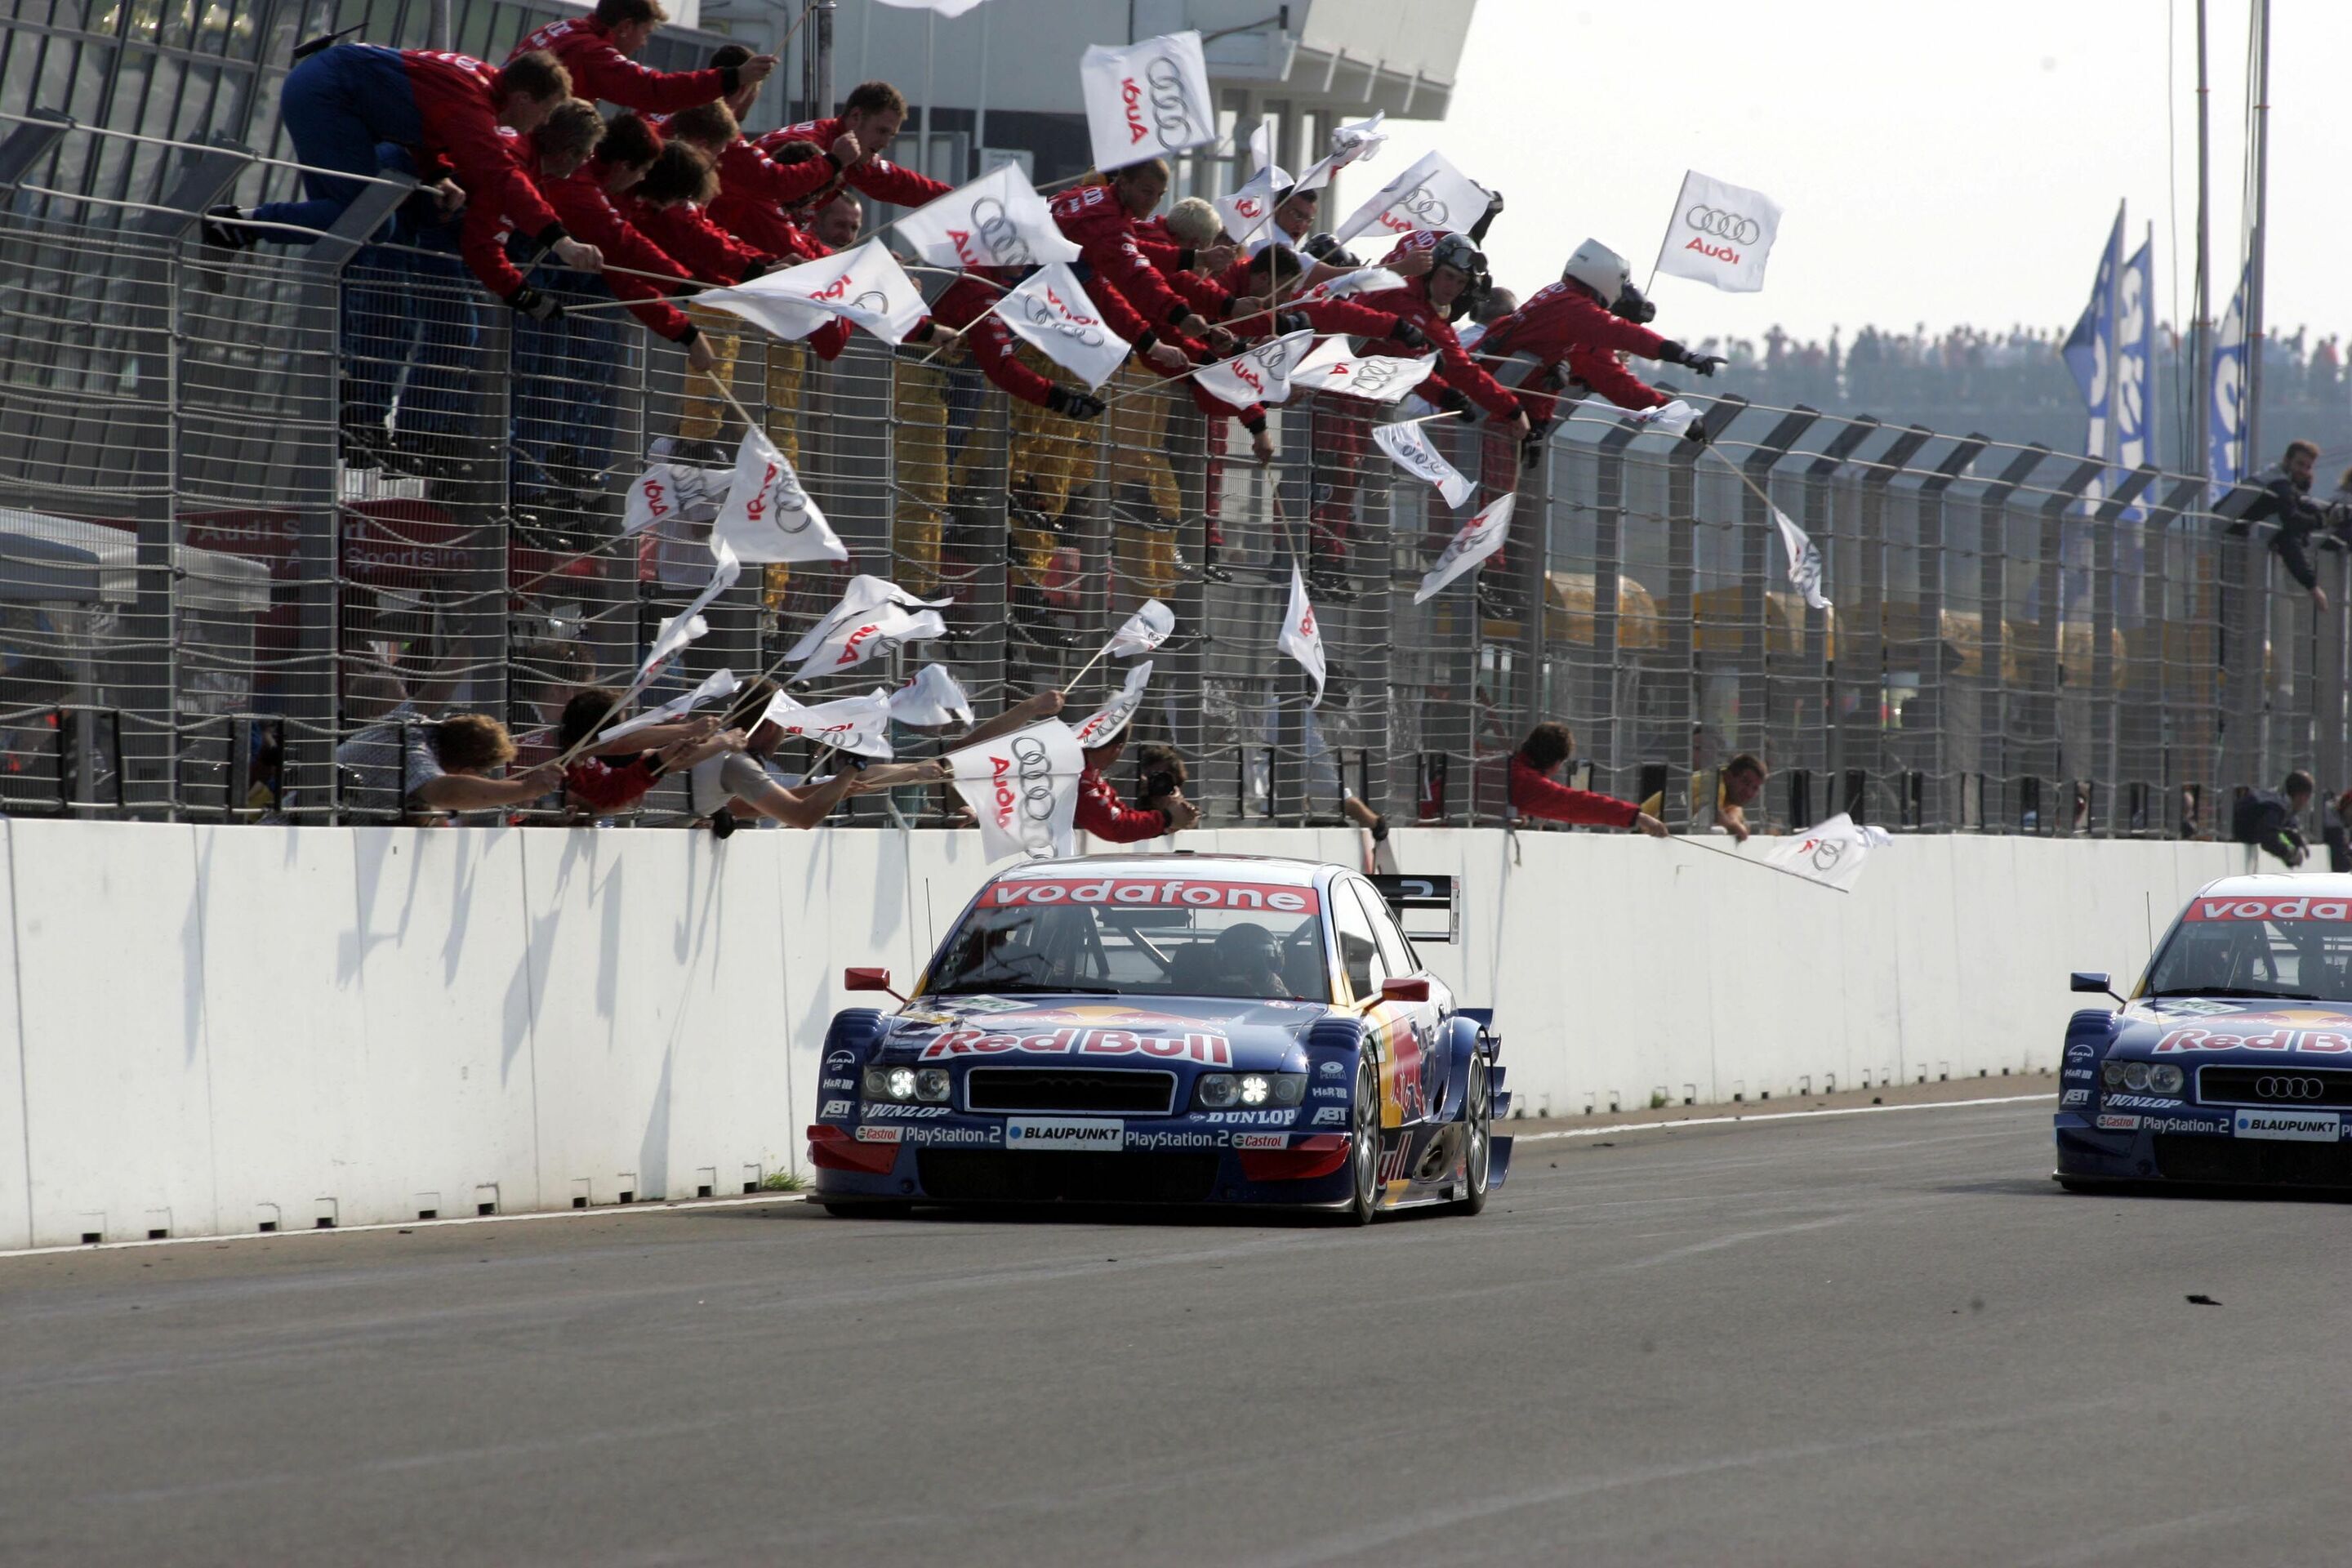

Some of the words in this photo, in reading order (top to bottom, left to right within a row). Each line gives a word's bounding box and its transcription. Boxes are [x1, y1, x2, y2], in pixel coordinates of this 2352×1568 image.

[1685, 237, 1740, 265] Audi
[198, 519, 272, 541] Audi
[283, 519, 367, 541] Srt
[345, 546, 469, 572] Sportslin
[989, 756, 1016, 815] Audi
[997, 880, 1306, 910] vodafone
[2204, 898, 2349, 920] voda
[919, 1028, 1080, 1062] Red
[1079, 1029, 1233, 1067] Bull
[2152, 1028, 2296, 1054] Red
[823, 1078, 842, 1089] H&R
[1312, 1086, 1334, 1098] H&R
[2062, 1089, 2090, 1104] ABT
[2106, 1094, 2183, 1109] DUNLOP
[820, 1100, 851, 1118] ABT
[866, 1103, 952, 1118] DUNLOP
[1206, 1109, 1295, 1125] DUNLOP
[1311, 1107, 1348, 1125] ABT
[2106, 1116, 2134, 1127] Castrol
[2143, 1118, 2214, 1134] PlayStation
[2250, 1119, 2336, 1133] BLAUPUNKT
[866, 1128, 898, 1140] Castrol
[906, 1127, 984, 1146] PlayStation
[1023, 1127, 1120, 1141] BLAUPUNKT
[1125, 1132, 1212, 1151] PlayStation
[1245, 1134, 1282, 1147] Castrol
[1377, 1130, 1414, 1190] ull
